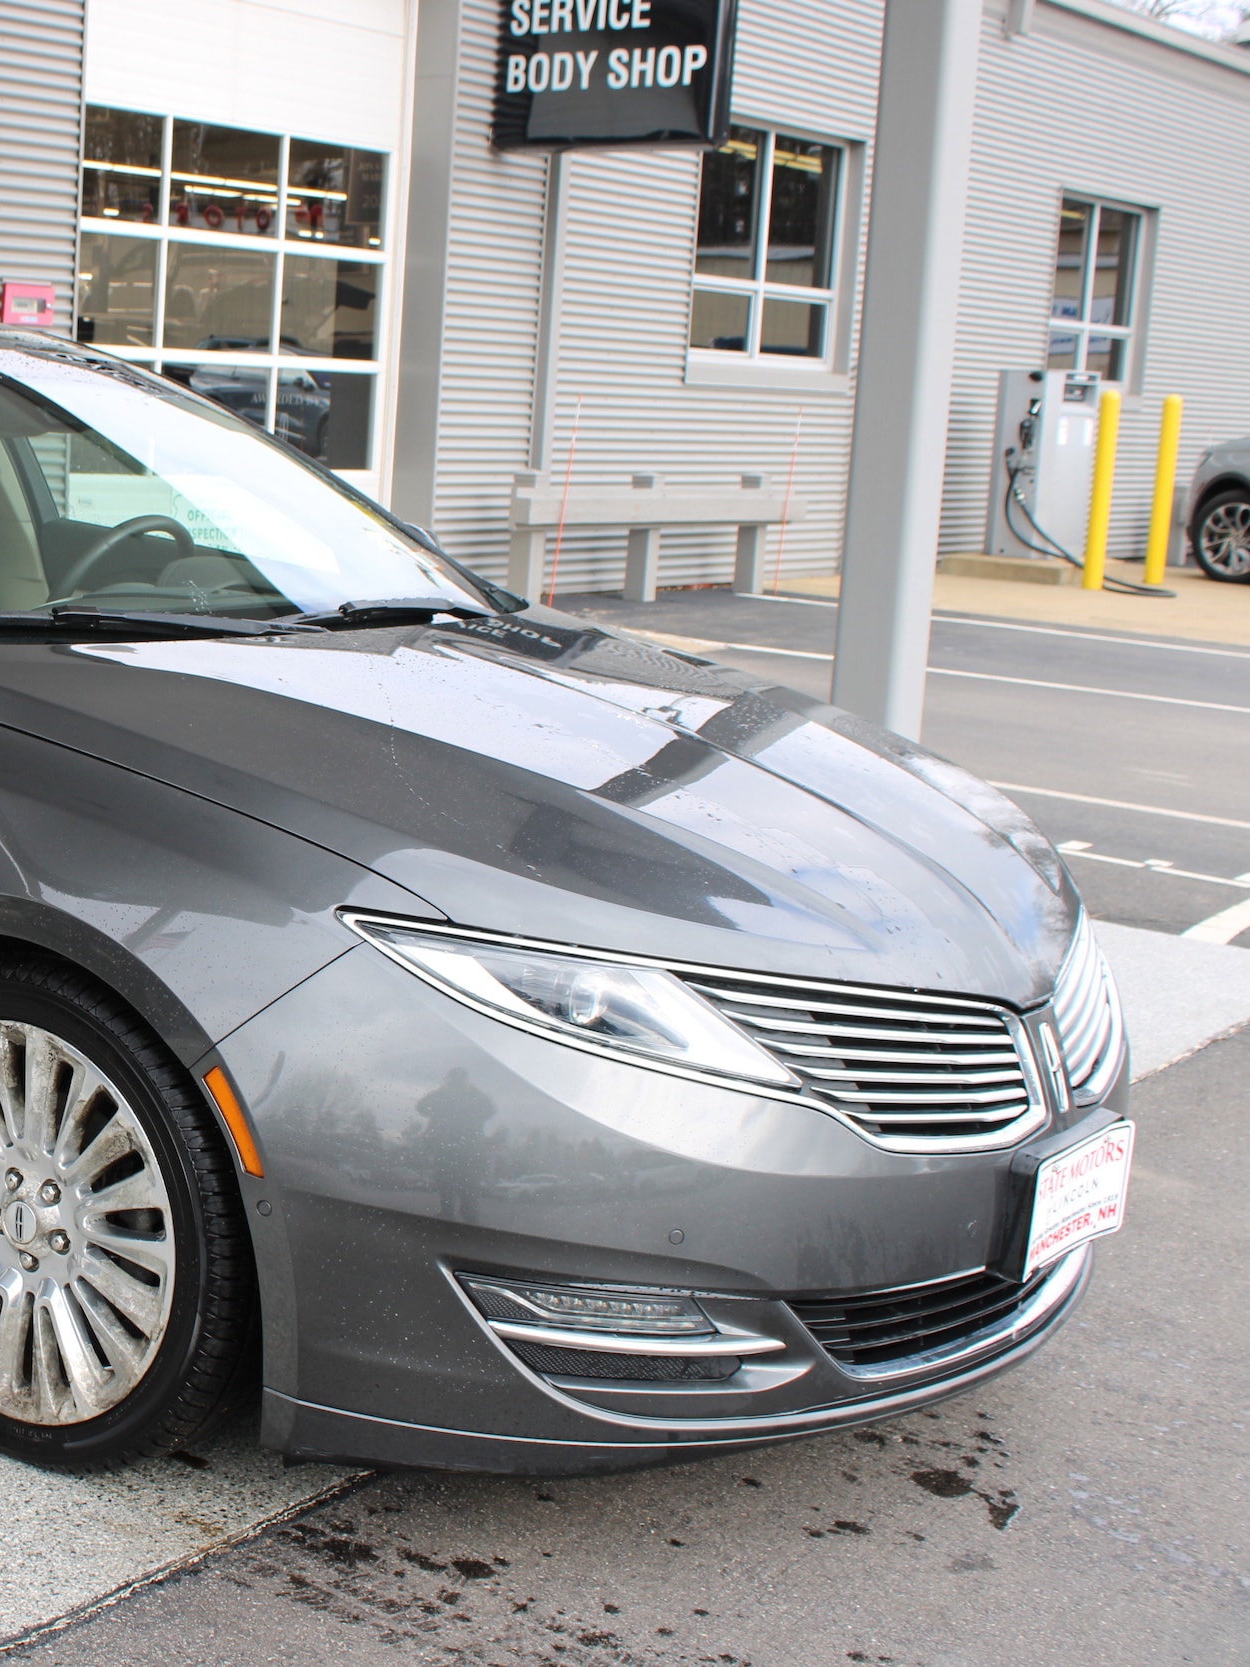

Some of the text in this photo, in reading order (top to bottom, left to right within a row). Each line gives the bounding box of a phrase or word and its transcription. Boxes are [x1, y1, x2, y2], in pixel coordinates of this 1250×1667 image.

[510, 0, 651, 36] SERVICE
[506, 44, 707, 93] BODY SHOP
[1070, 1139, 1125, 1181] MOTORS
[1097, 1203, 1117, 1220] NH
